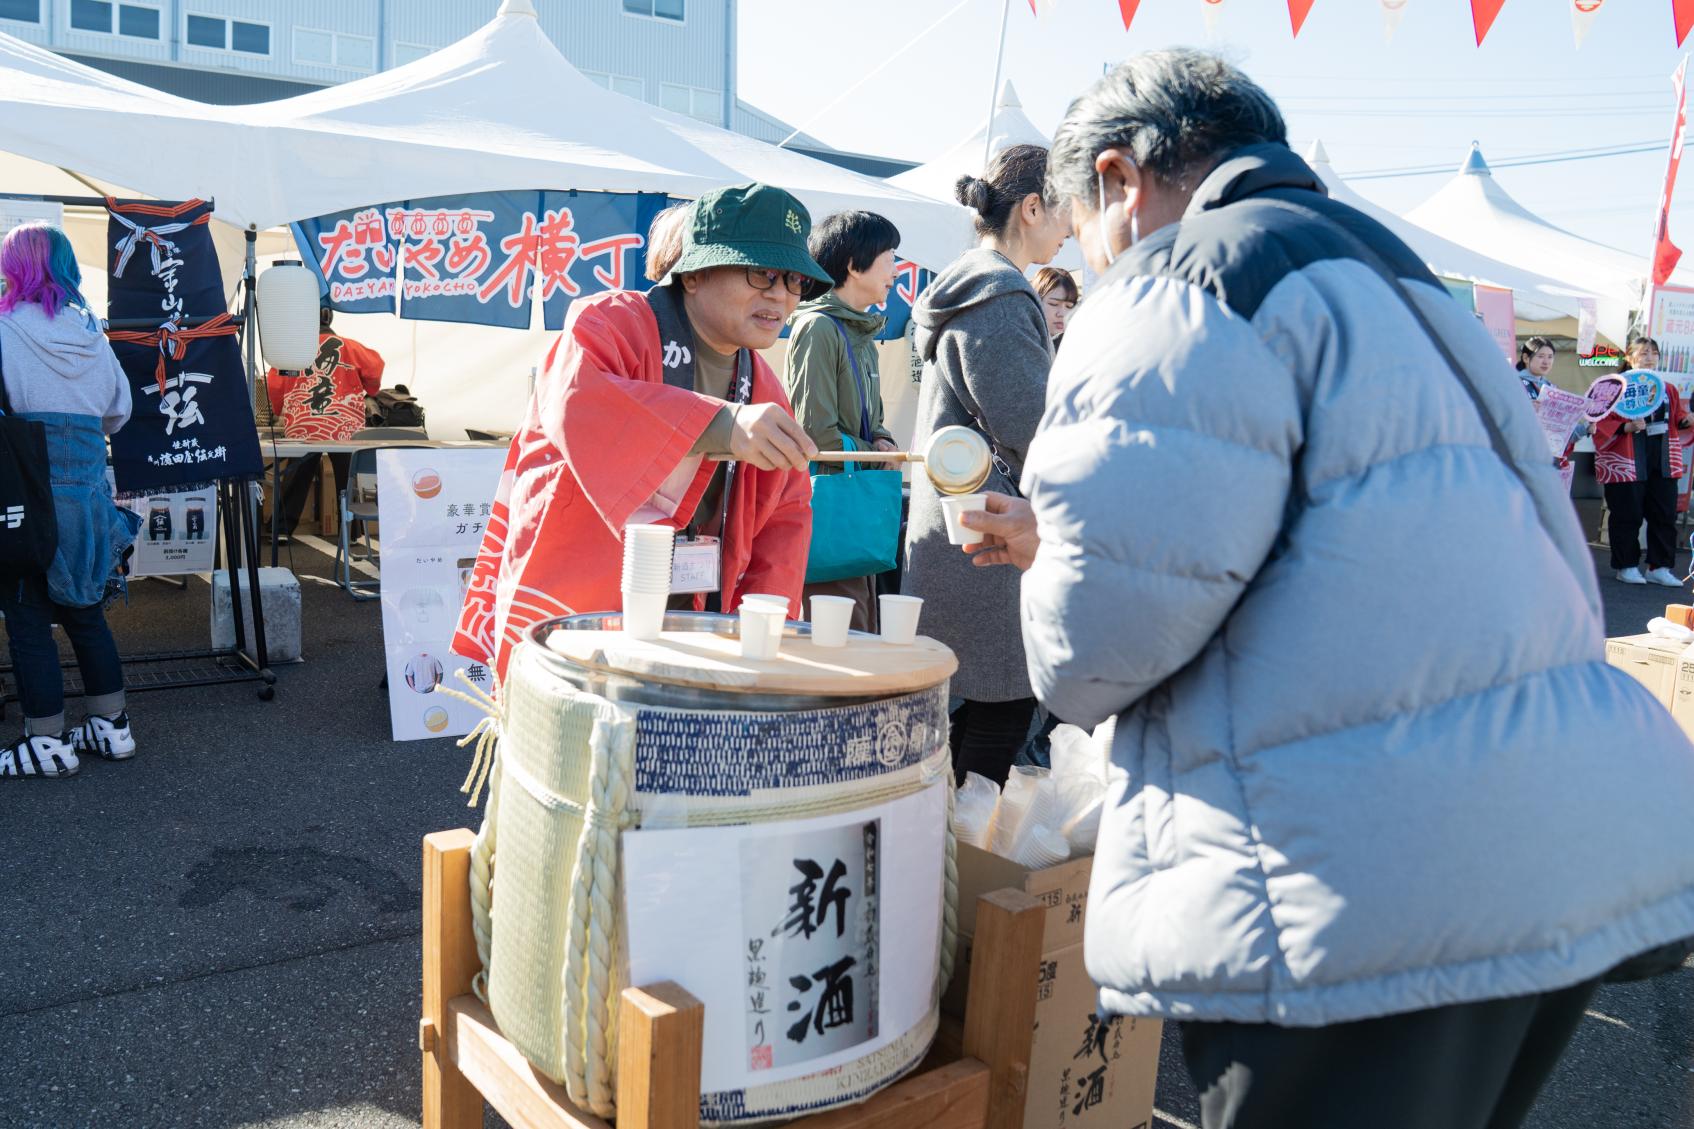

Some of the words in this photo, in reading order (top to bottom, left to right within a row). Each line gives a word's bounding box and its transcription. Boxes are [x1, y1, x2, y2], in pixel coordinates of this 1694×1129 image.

[662, 340, 692, 369] か
[1578, 357, 1620, 367] WELCOME
[467, 664, 487, 682] 無
[770, 857, 857, 1044] 新酒
